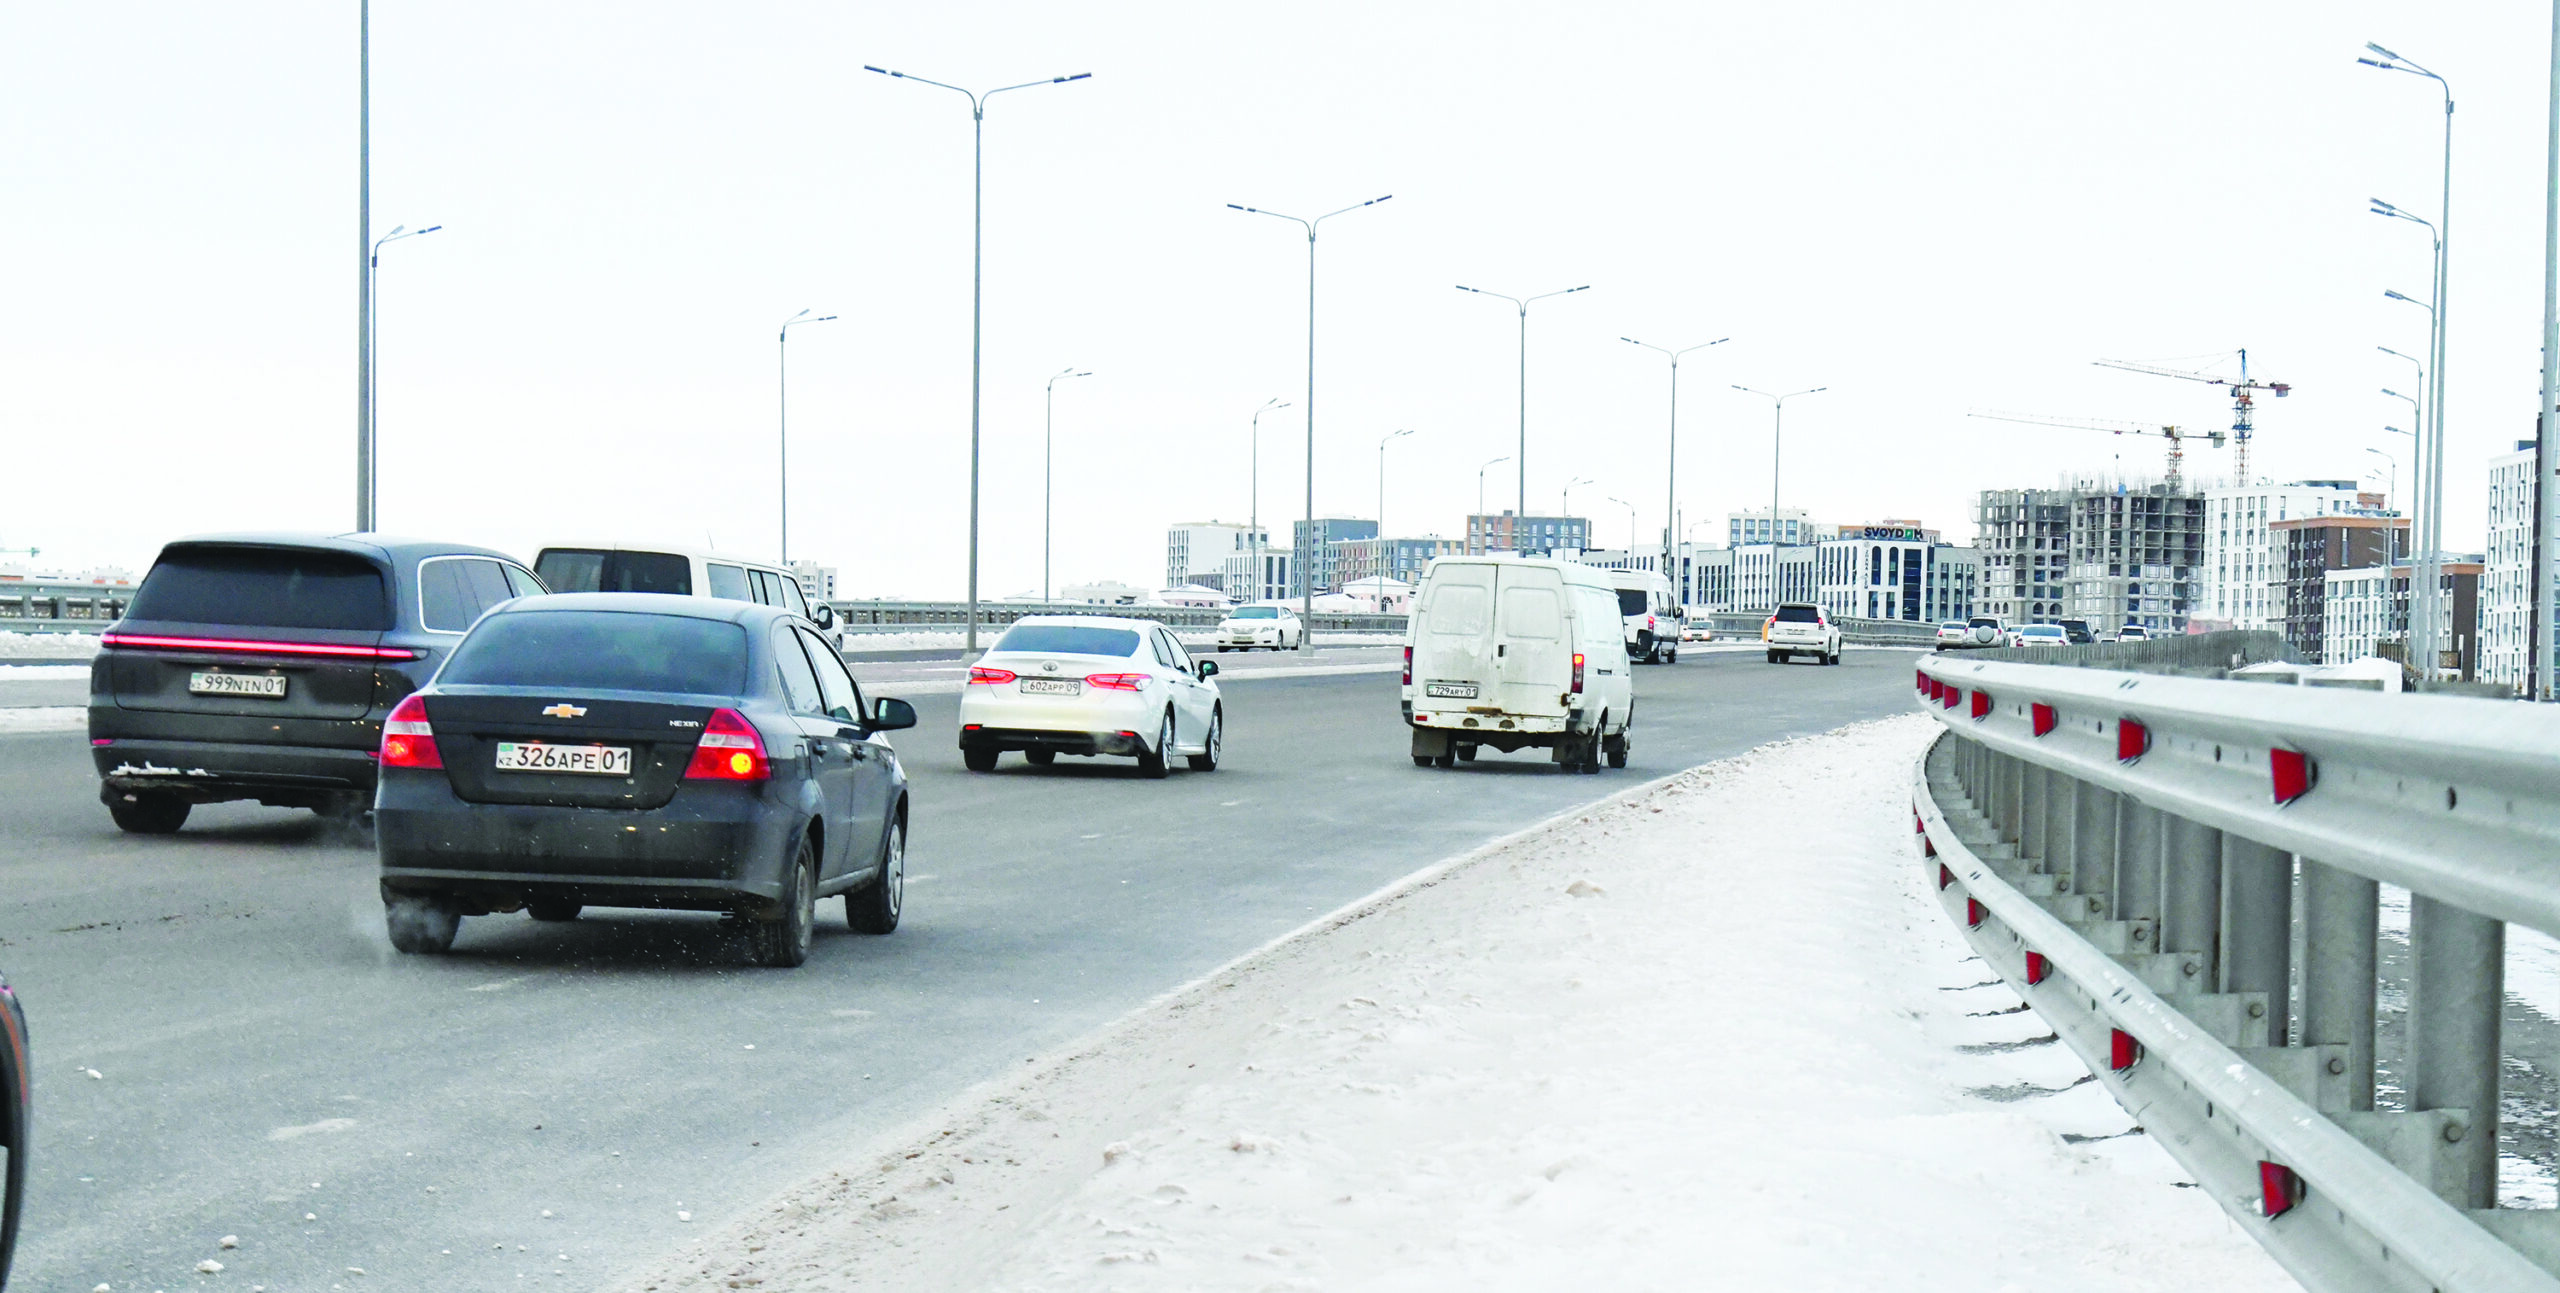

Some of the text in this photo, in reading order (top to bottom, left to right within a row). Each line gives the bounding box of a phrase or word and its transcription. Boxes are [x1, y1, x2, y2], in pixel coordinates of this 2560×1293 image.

[265, 678, 285, 693] 01
[498, 757, 512, 767] KZ
[516, 746, 629, 771] 326APE 01
